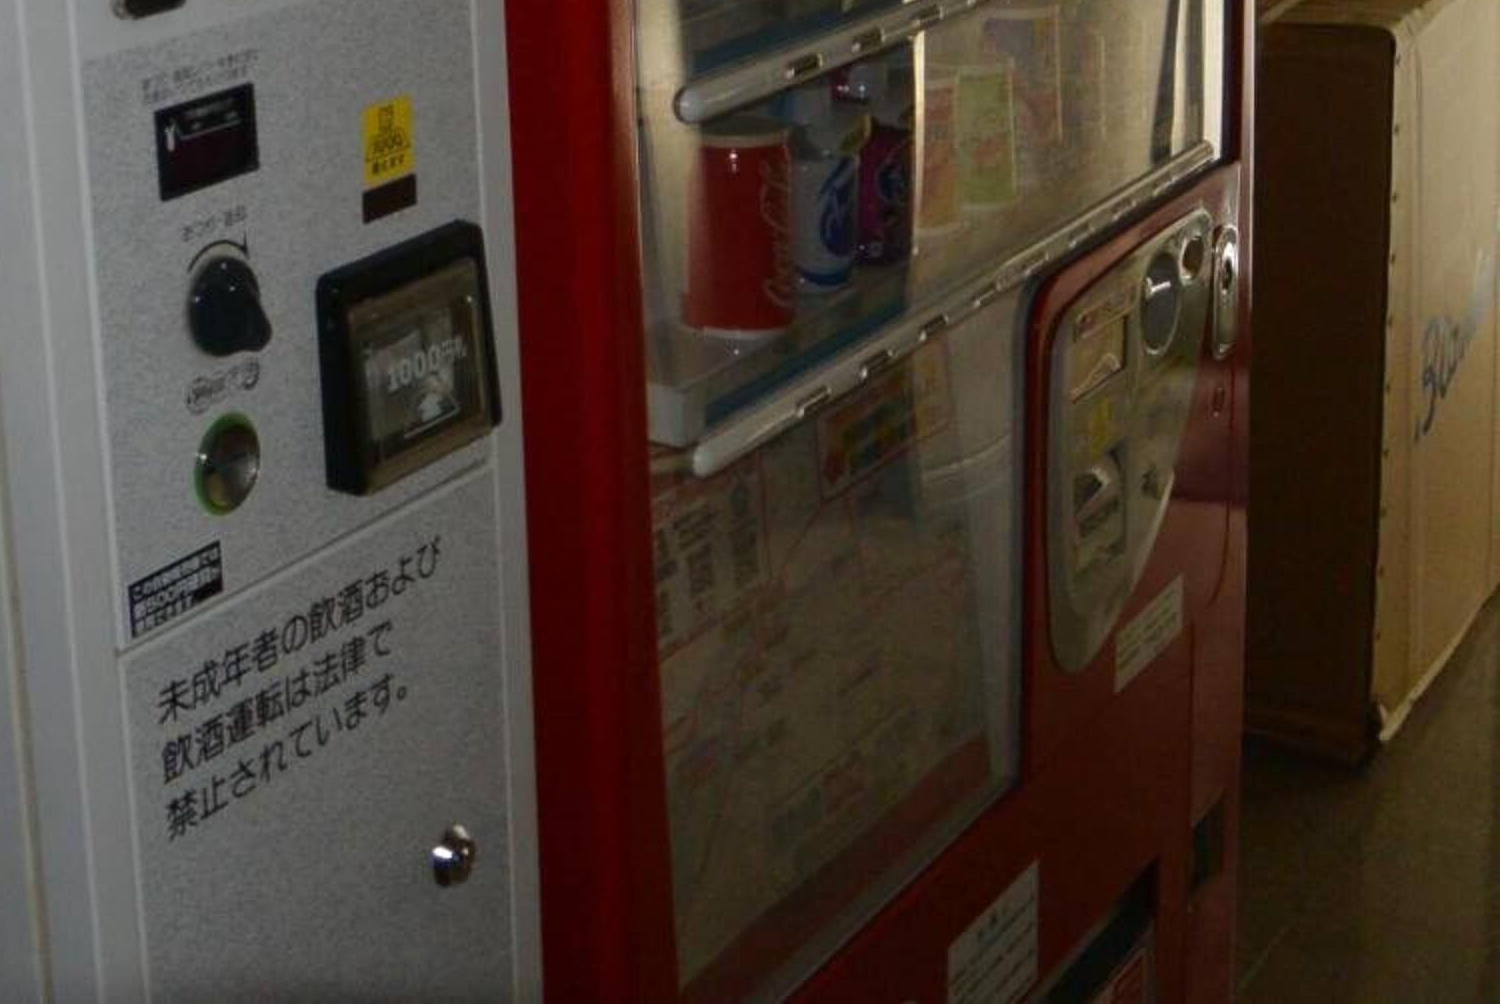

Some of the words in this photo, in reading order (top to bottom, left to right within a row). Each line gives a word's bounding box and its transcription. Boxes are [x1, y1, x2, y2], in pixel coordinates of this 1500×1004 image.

[157, 535, 443, 725] 未成年者の飲酒および
[161, 620, 393, 784] 飲酒運転は法律で
[166, 673, 408, 841] 禁止されています。
